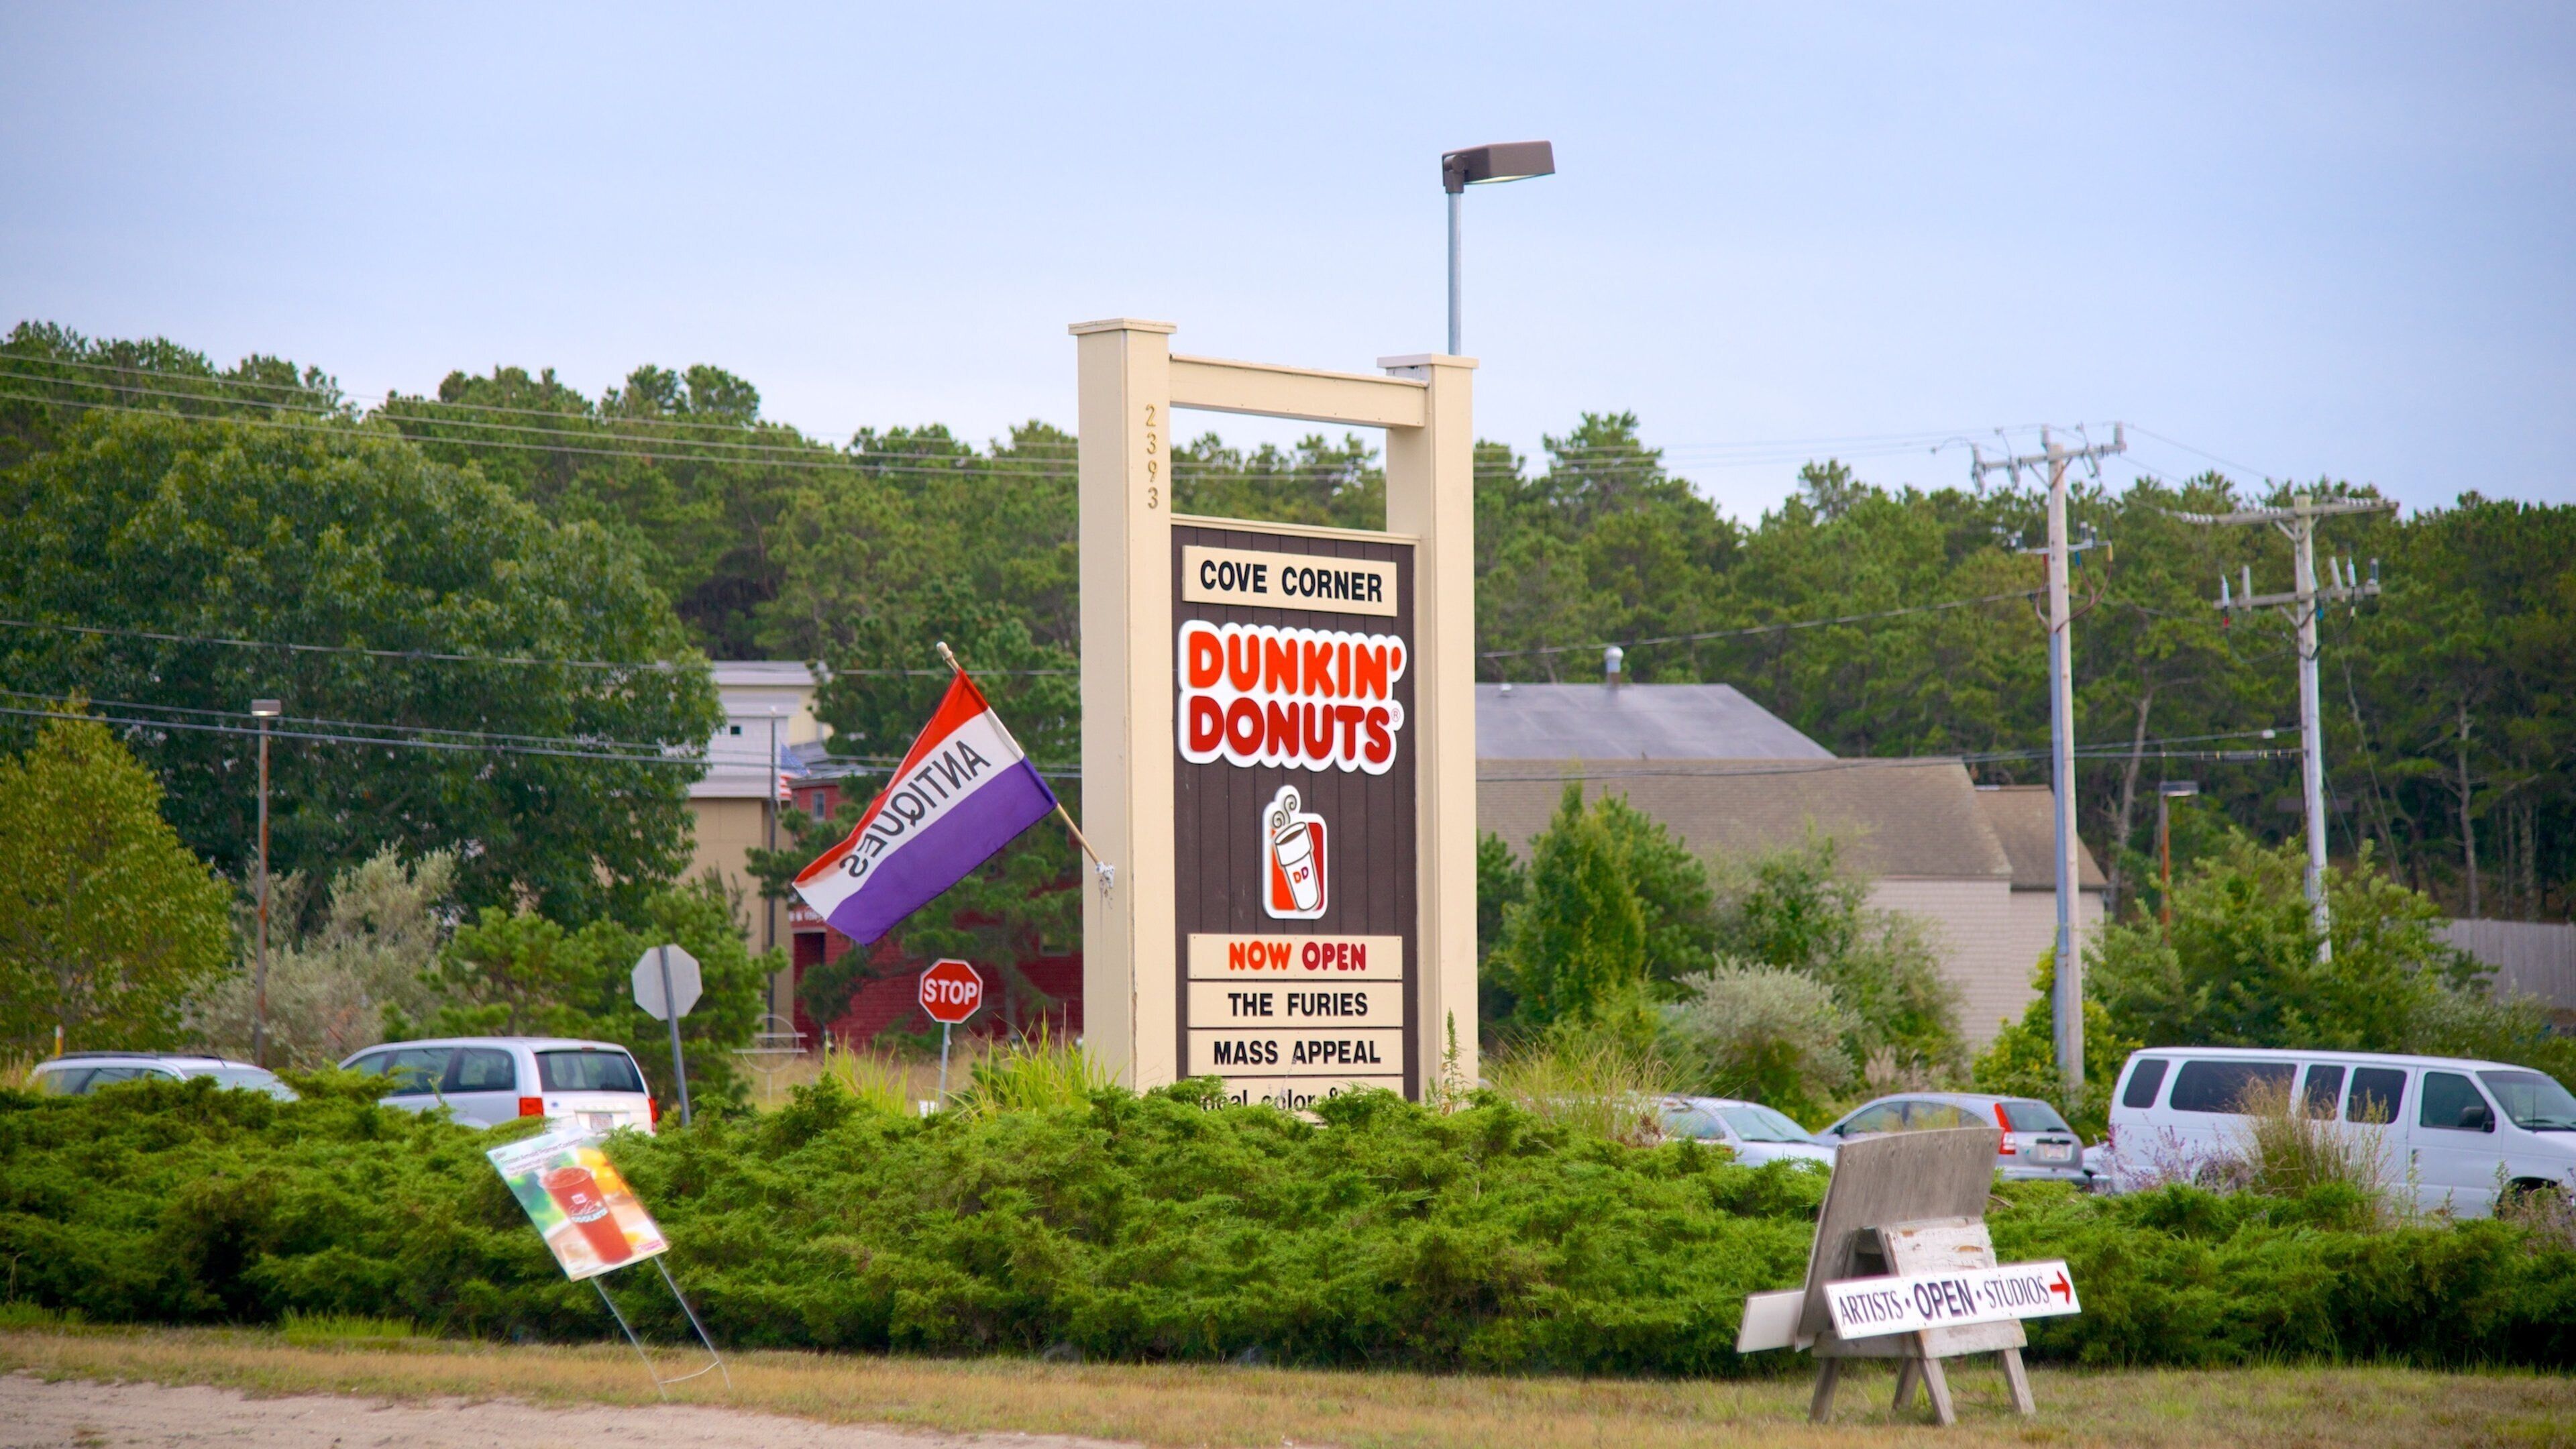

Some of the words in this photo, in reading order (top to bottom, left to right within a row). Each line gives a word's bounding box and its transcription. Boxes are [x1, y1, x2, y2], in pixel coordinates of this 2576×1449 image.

[1145, 404, 1159, 509] 2393
[1200, 559, 1267, 594] COVE
[1281, 566, 1383, 602] CORNER
[1189, 630, 1402, 700] DUNKIN'
[1189, 695, 1391, 764] DONUTS
[1293, 866, 1309, 884] DD
[1229, 941, 1292, 971] NOW
[1301, 941, 1366, 971] OPEN
[924, 978, 978, 1005] STOP
[1228, 993, 1273, 1016] THE
[1287, 992, 1368, 1016] FURIES
[1214, 1040, 1279, 1065] MASS
[1292, 1040, 1381, 1064] APPEAL
[1839, 1289, 1904, 1326] ARTISTS
[1913, 1278, 1978, 1321] OPEN
[1984, 1275, 2050, 1309] STUDIOS
